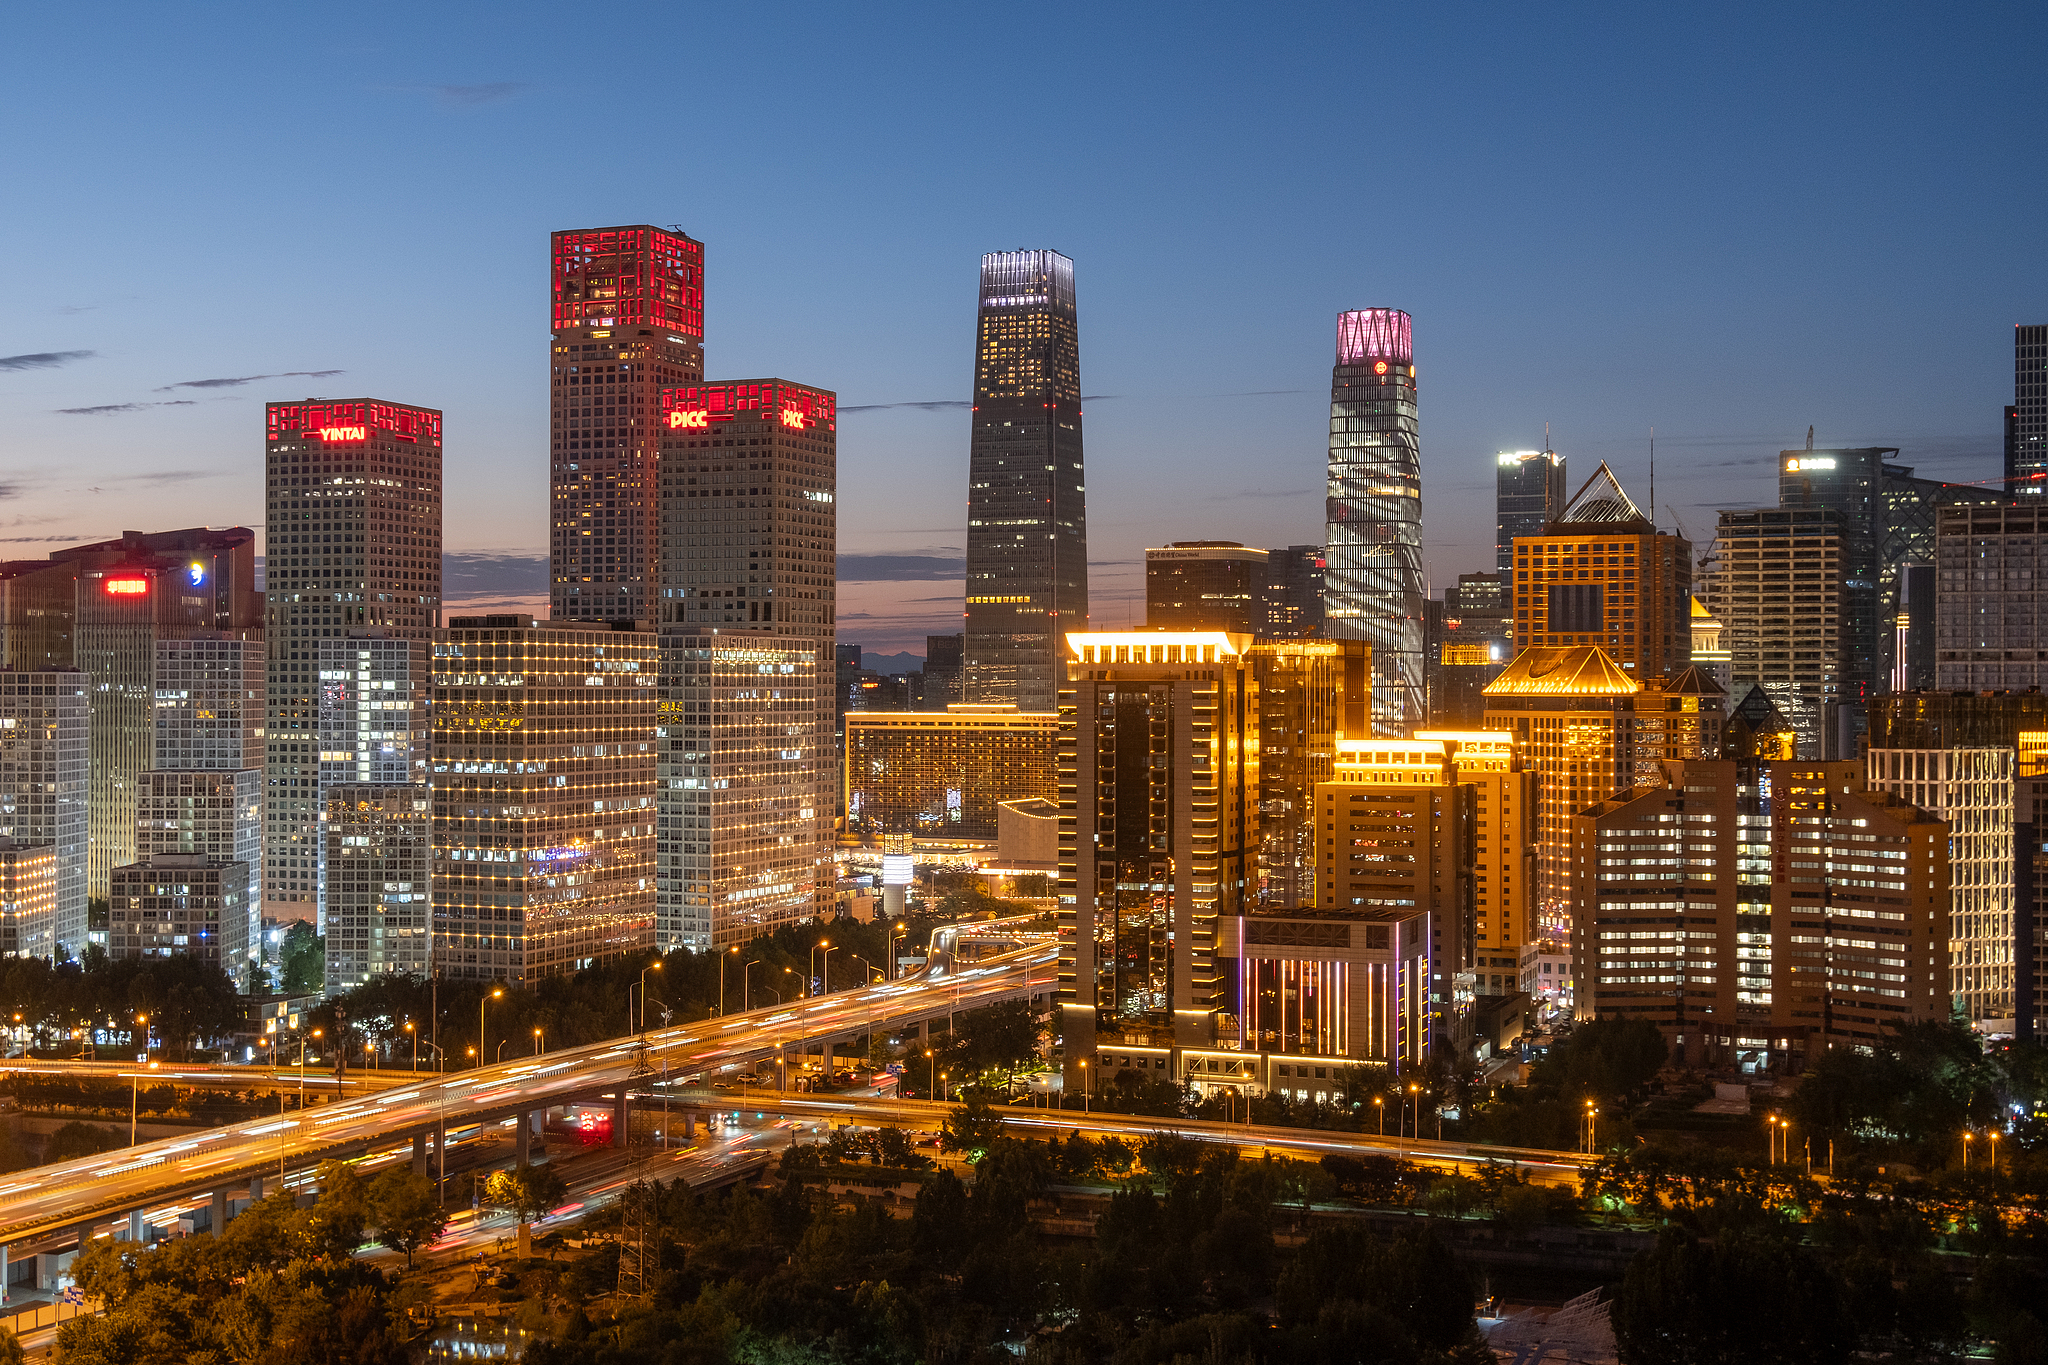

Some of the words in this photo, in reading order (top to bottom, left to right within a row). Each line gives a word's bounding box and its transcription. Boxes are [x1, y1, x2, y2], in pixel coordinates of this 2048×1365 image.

[671, 411, 707, 428] PICC
[783, 409, 803, 429] PICC
[320, 427, 364, 441] YINTAI
